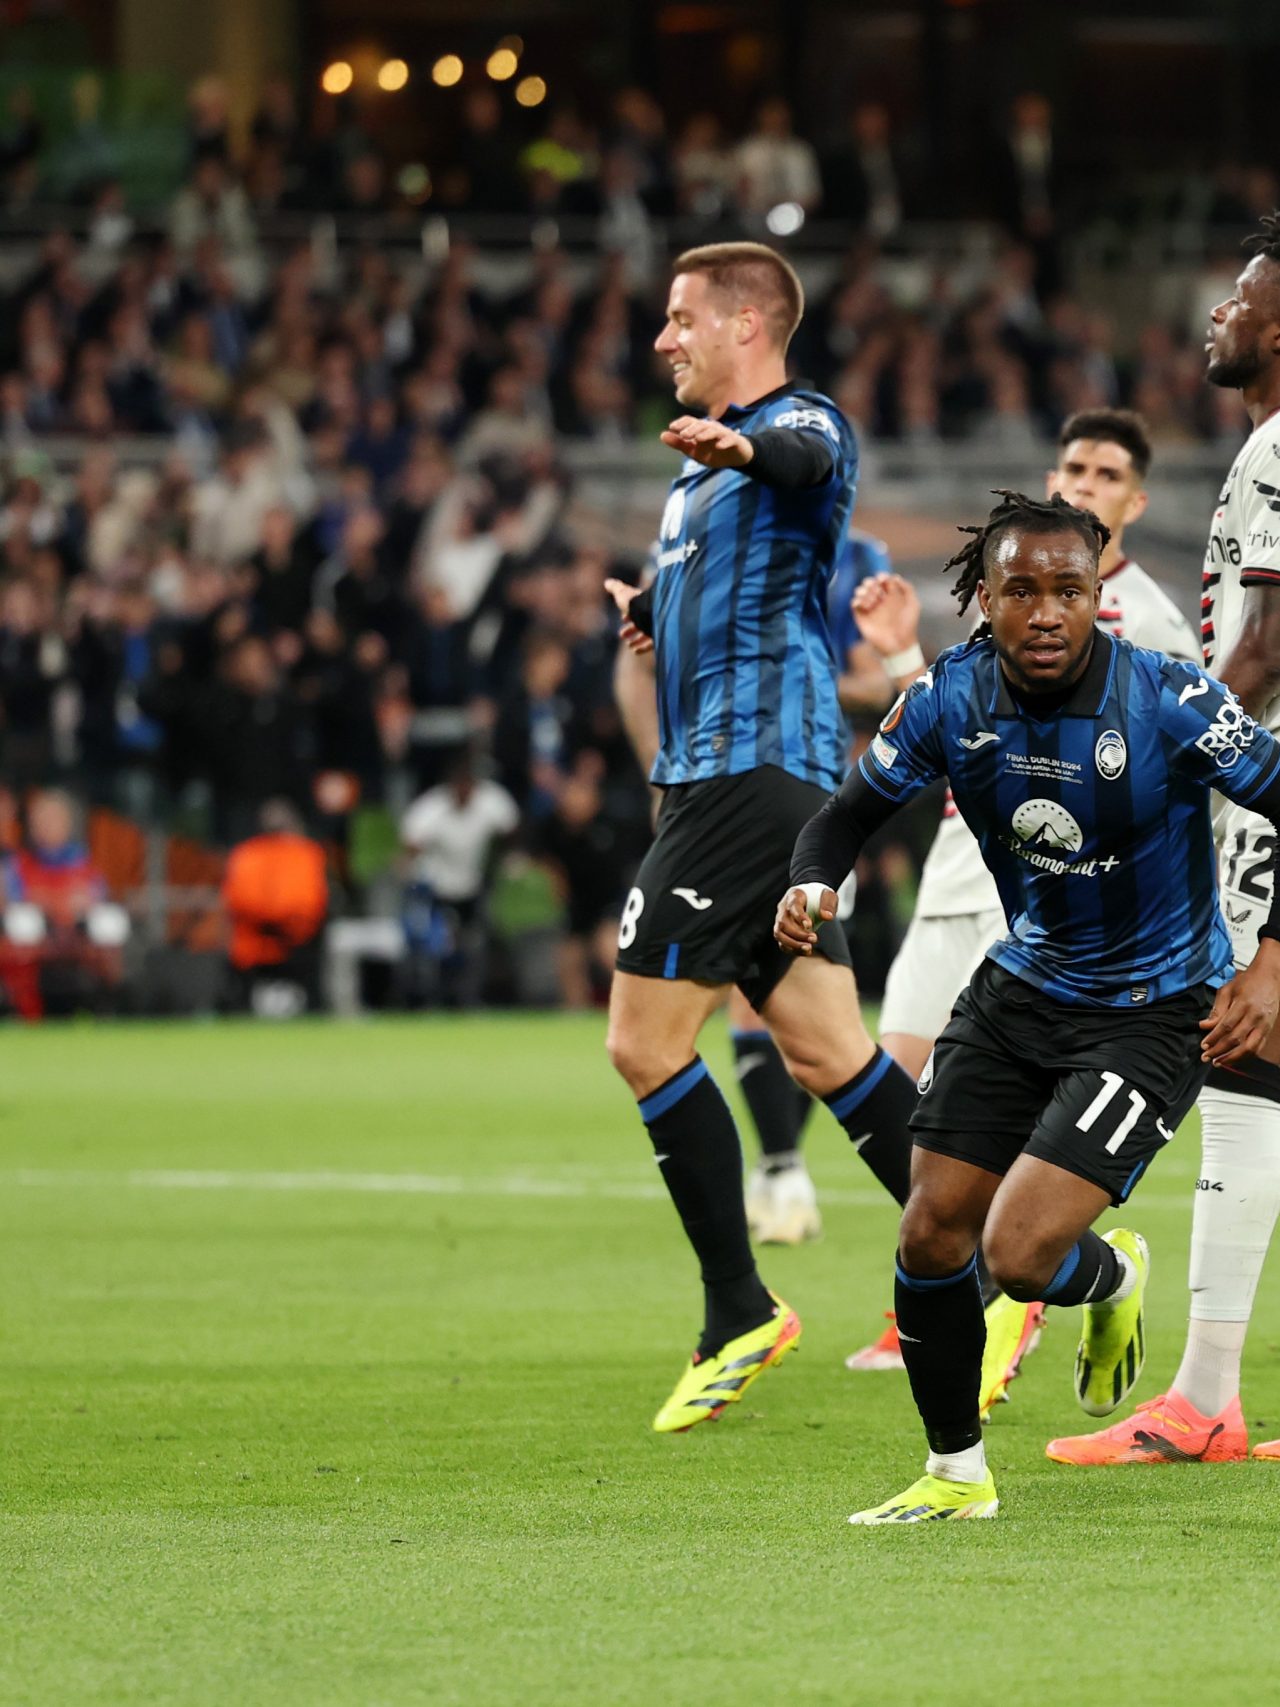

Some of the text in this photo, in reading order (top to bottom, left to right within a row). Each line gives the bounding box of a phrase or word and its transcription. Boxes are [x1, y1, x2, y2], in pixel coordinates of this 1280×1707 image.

[1006, 753, 1082, 771] FINAL DUBLIN 2024
[1225, 827, 1277, 901] 12
[618, 886, 645, 950] 8
[1075, 1070, 1147, 1156] 11
